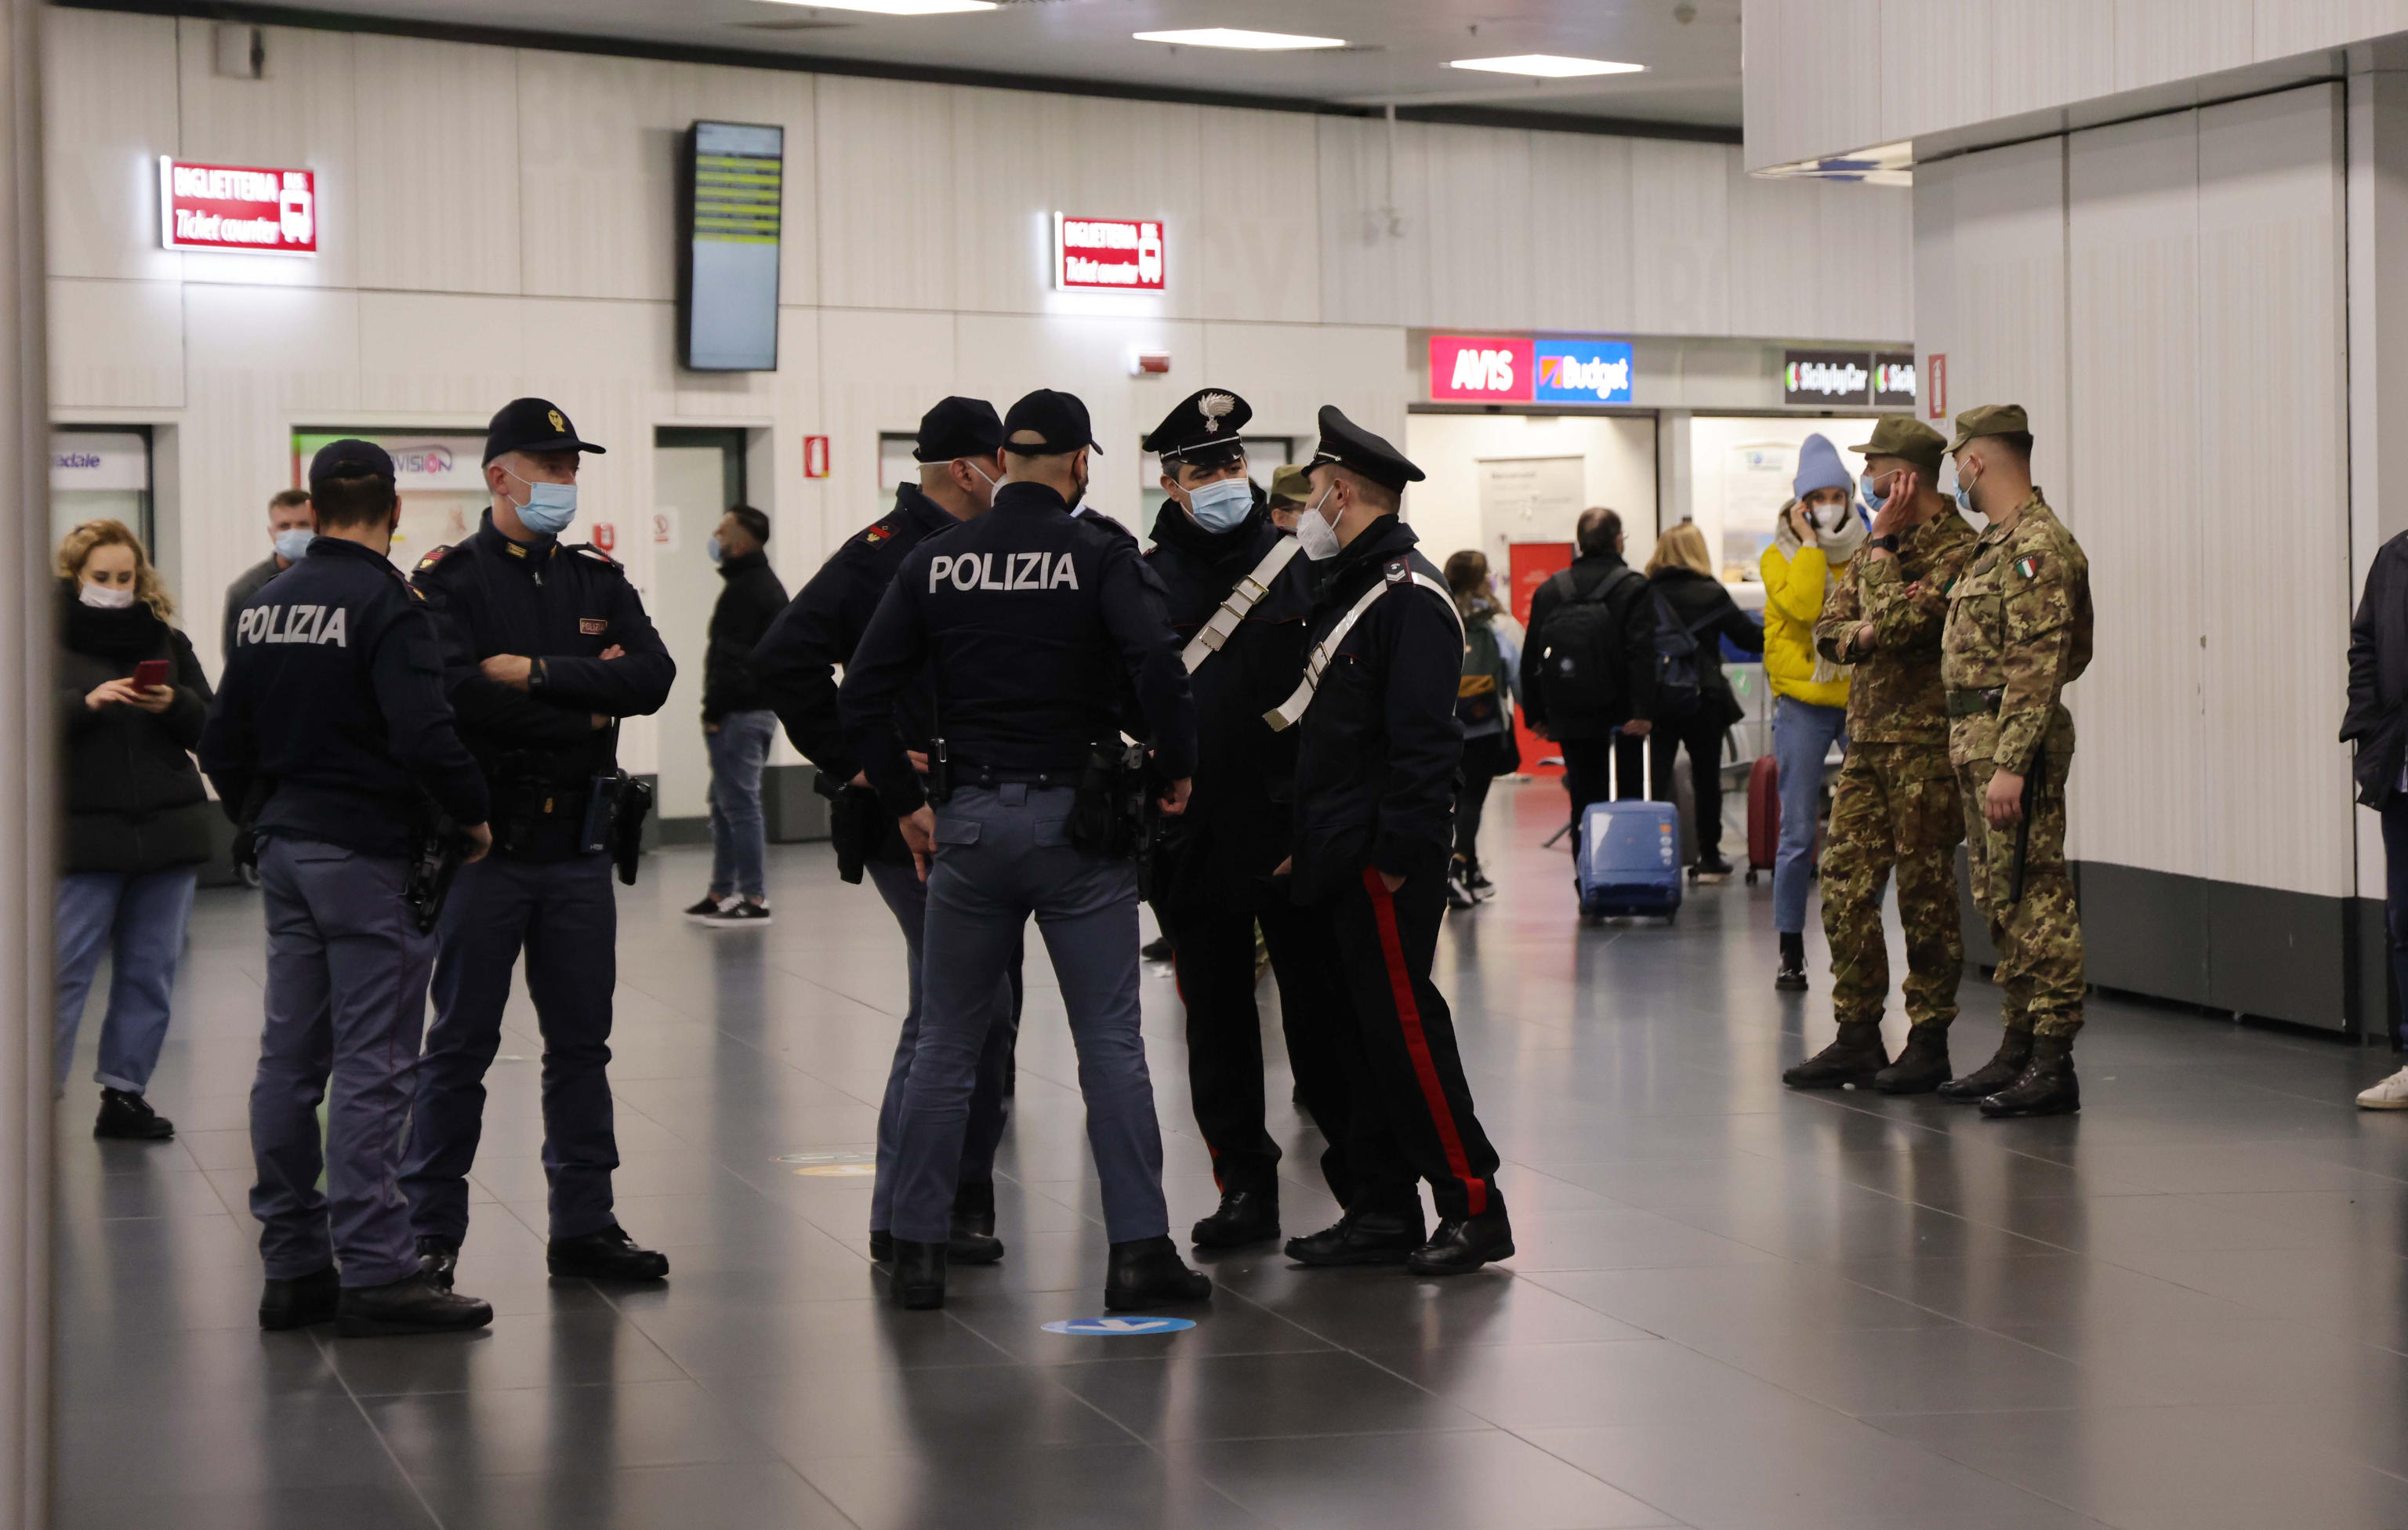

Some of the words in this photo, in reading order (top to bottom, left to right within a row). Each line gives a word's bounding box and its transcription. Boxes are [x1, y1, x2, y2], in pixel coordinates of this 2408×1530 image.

[176, 208, 222, 241] Ticket
[220, 217, 280, 244] counter
[1451, 349, 1514, 391] AVIS
[1562, 355, 1629, 399] Budget
[392, 453, 452, 473] VISION
[929, 552, 1079, 593] POLIZIA
[237, 604, 346, 647] POLIZIA
[582, 621, 604, 632] POLIZ
